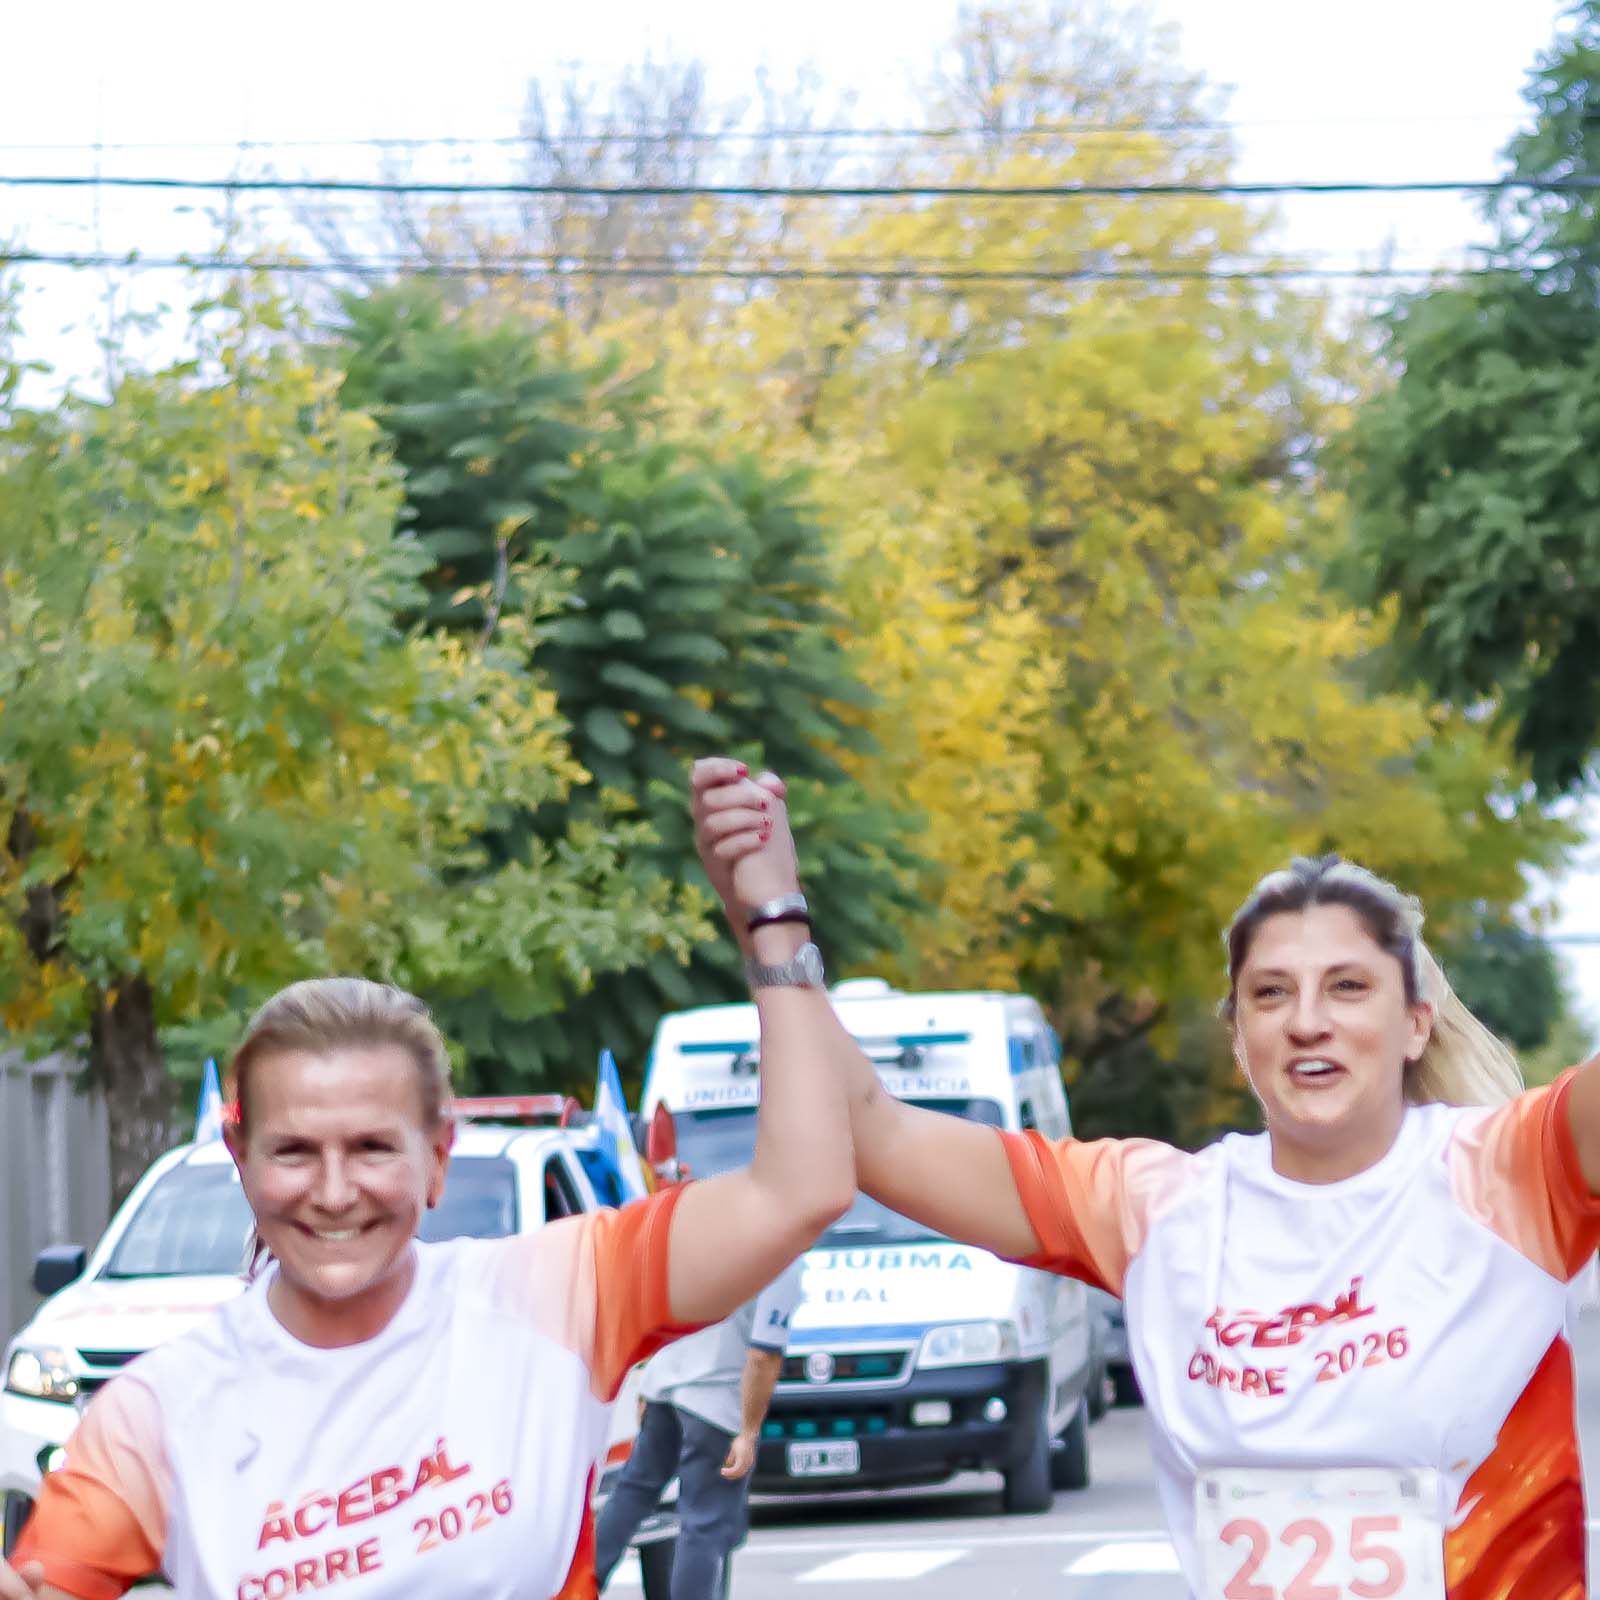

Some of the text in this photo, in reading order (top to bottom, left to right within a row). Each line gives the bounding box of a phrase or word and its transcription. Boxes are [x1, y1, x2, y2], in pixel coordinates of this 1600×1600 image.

[684, 1086, 760, 1103] UNIDA
[1315, 1326, 1408, 1382] 2026
[412, 1479, 514, 1554] 2026
[1220, 1516, 1406, 1600] 225
